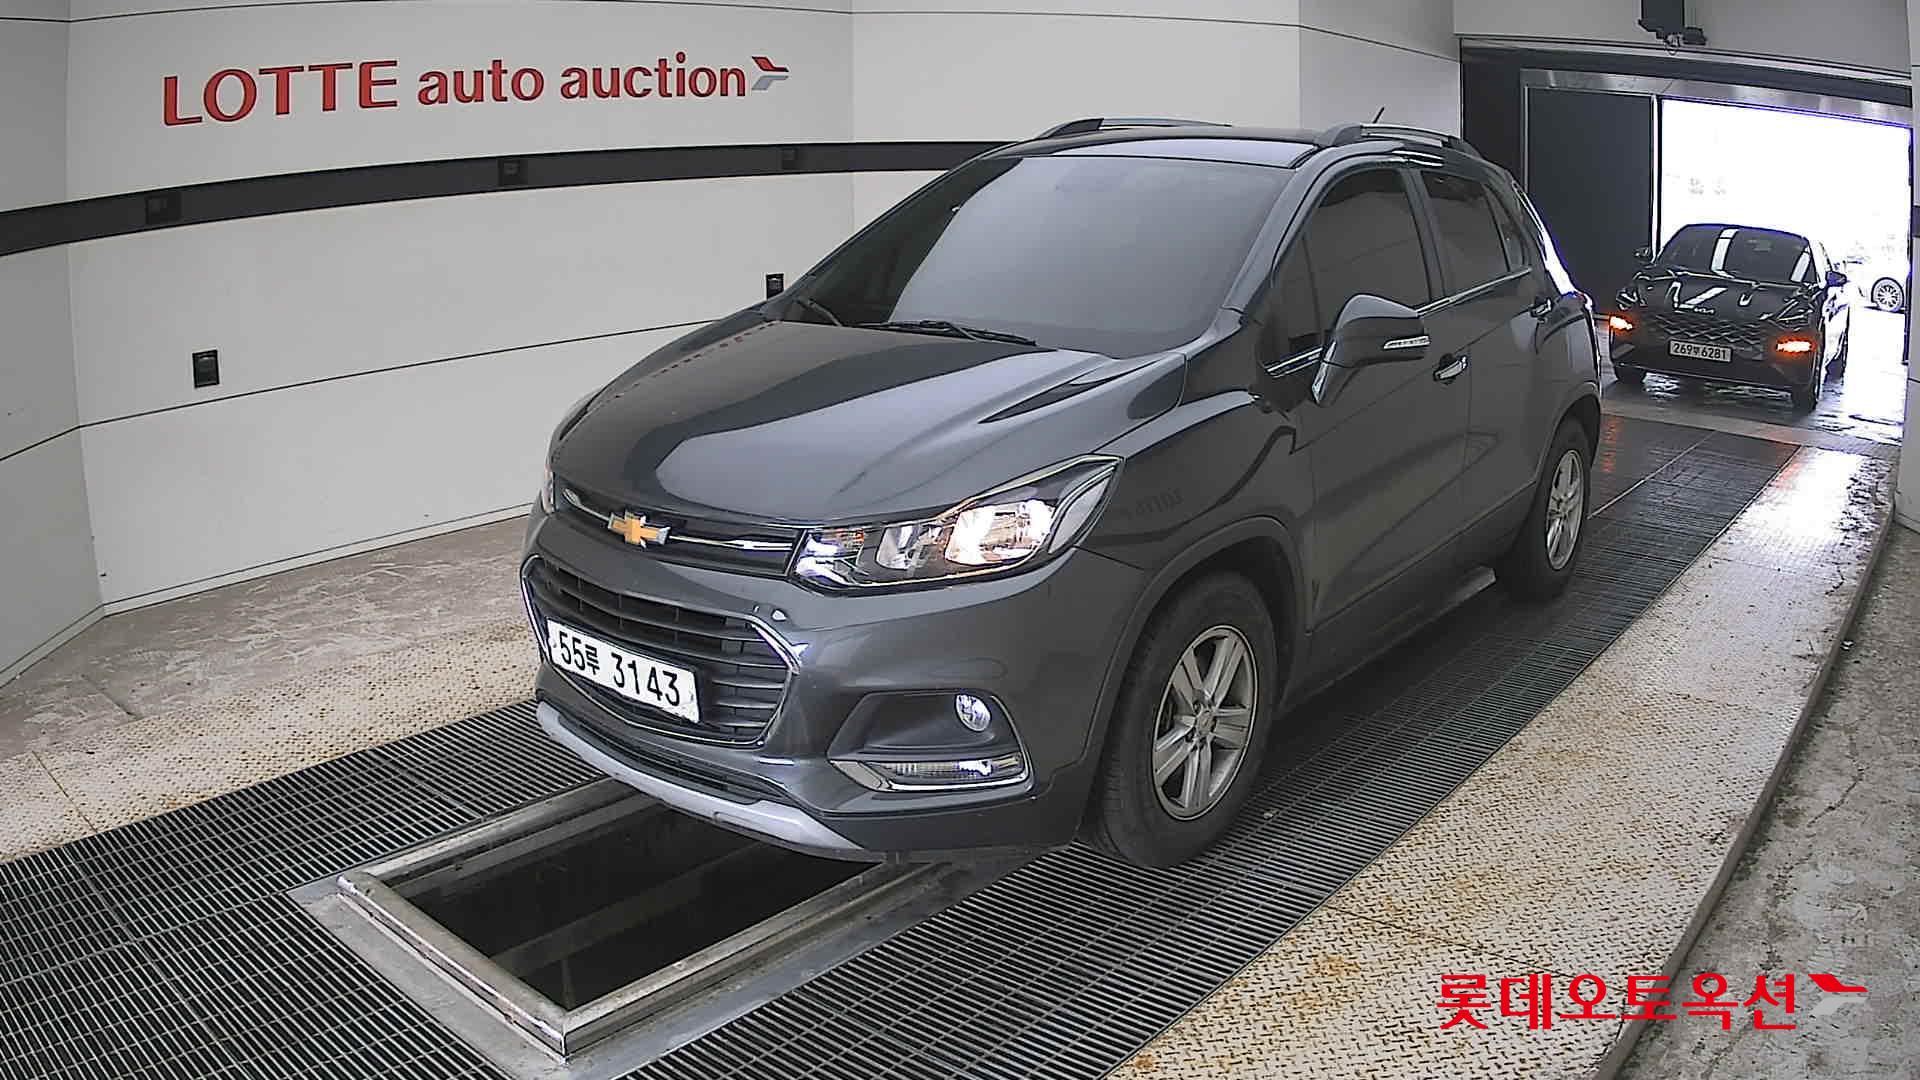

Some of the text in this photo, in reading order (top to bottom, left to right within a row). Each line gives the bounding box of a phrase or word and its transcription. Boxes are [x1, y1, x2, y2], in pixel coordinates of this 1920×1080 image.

[163, 53, 746, 126] LOTTE auto auction
[559, 630, 680, 706] 55루 3143
